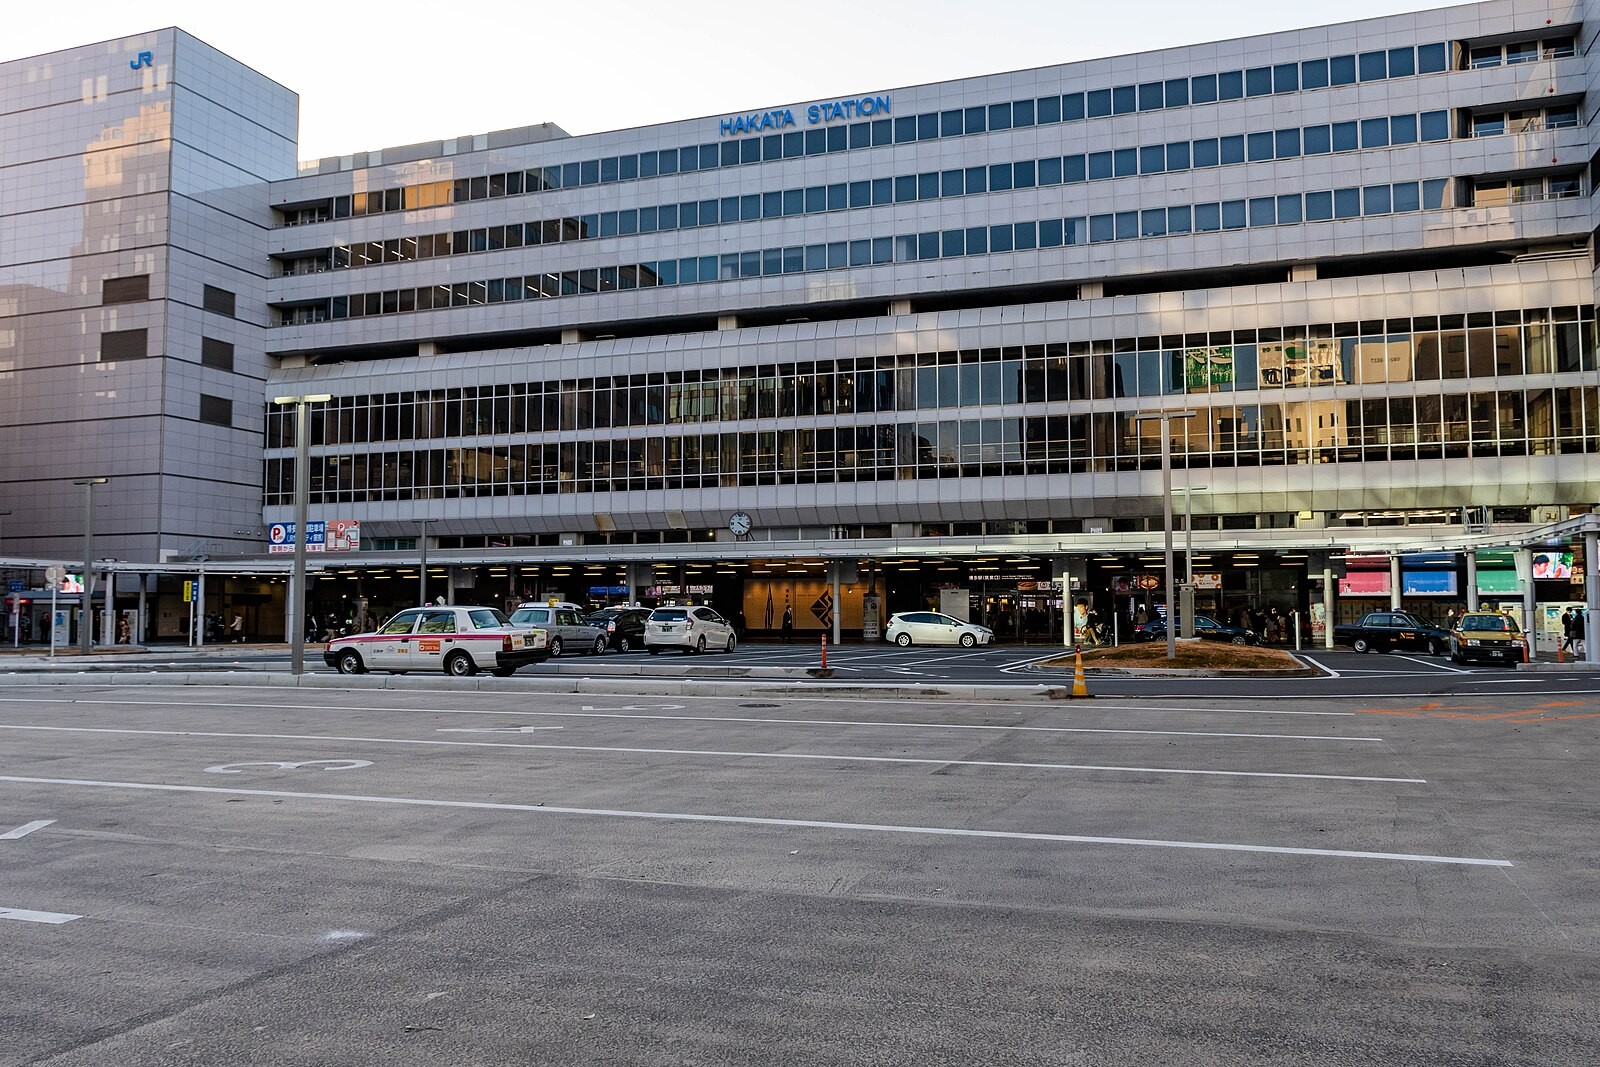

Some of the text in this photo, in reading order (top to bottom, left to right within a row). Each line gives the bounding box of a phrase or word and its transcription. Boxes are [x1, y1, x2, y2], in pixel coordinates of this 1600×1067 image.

[130, 51, 152, 69] JR
[720, 95, 890, 136] HAKATA STATION
[273, 528, 280, 540] P
